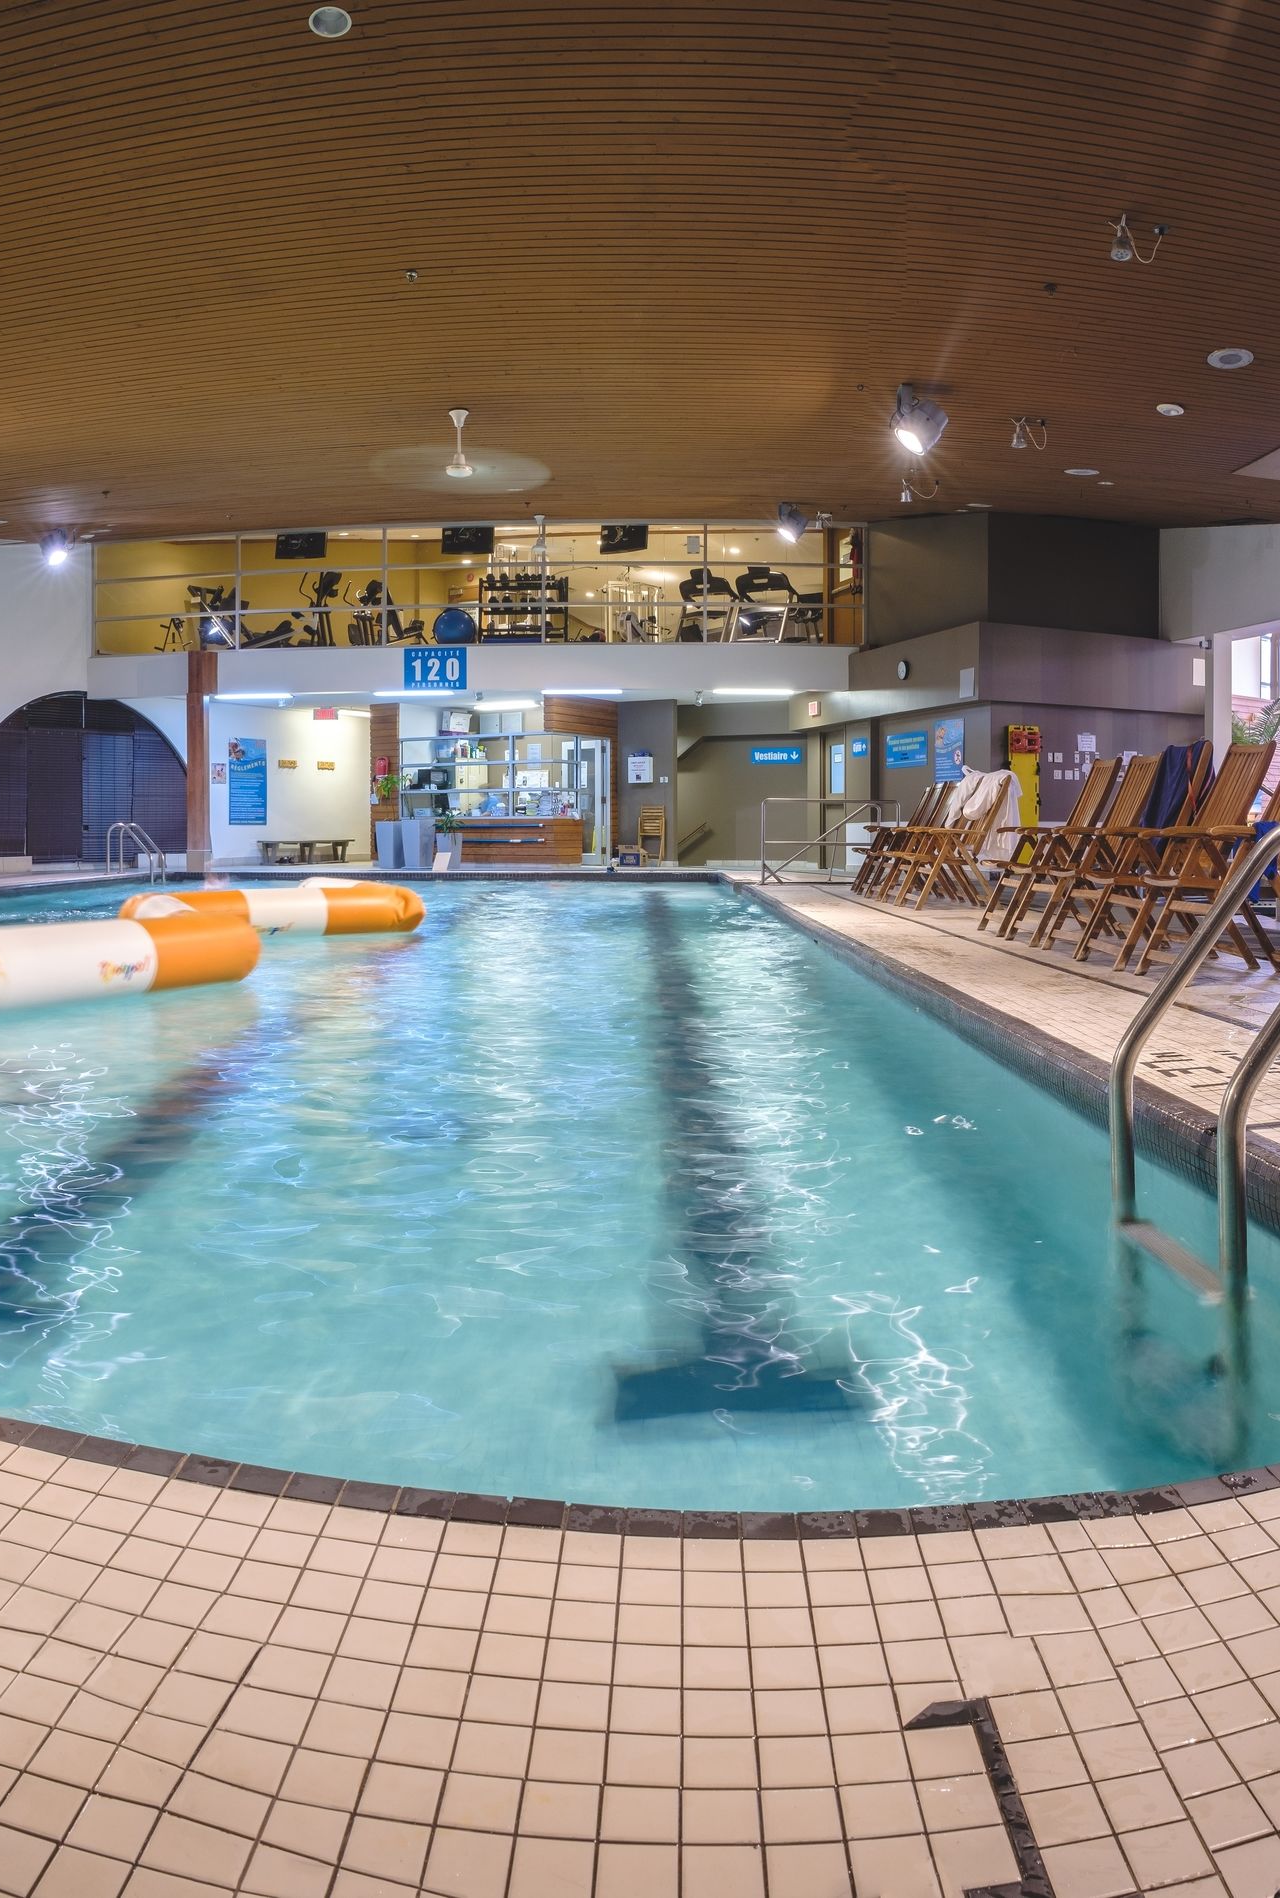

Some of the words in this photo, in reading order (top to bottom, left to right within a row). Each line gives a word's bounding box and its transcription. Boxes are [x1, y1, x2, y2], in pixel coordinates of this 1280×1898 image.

[411, 649, 460, 657] CAPACITÉ
[411, 657, 460, 681] 120
[754, 751, 788, 761] Vestiaire
